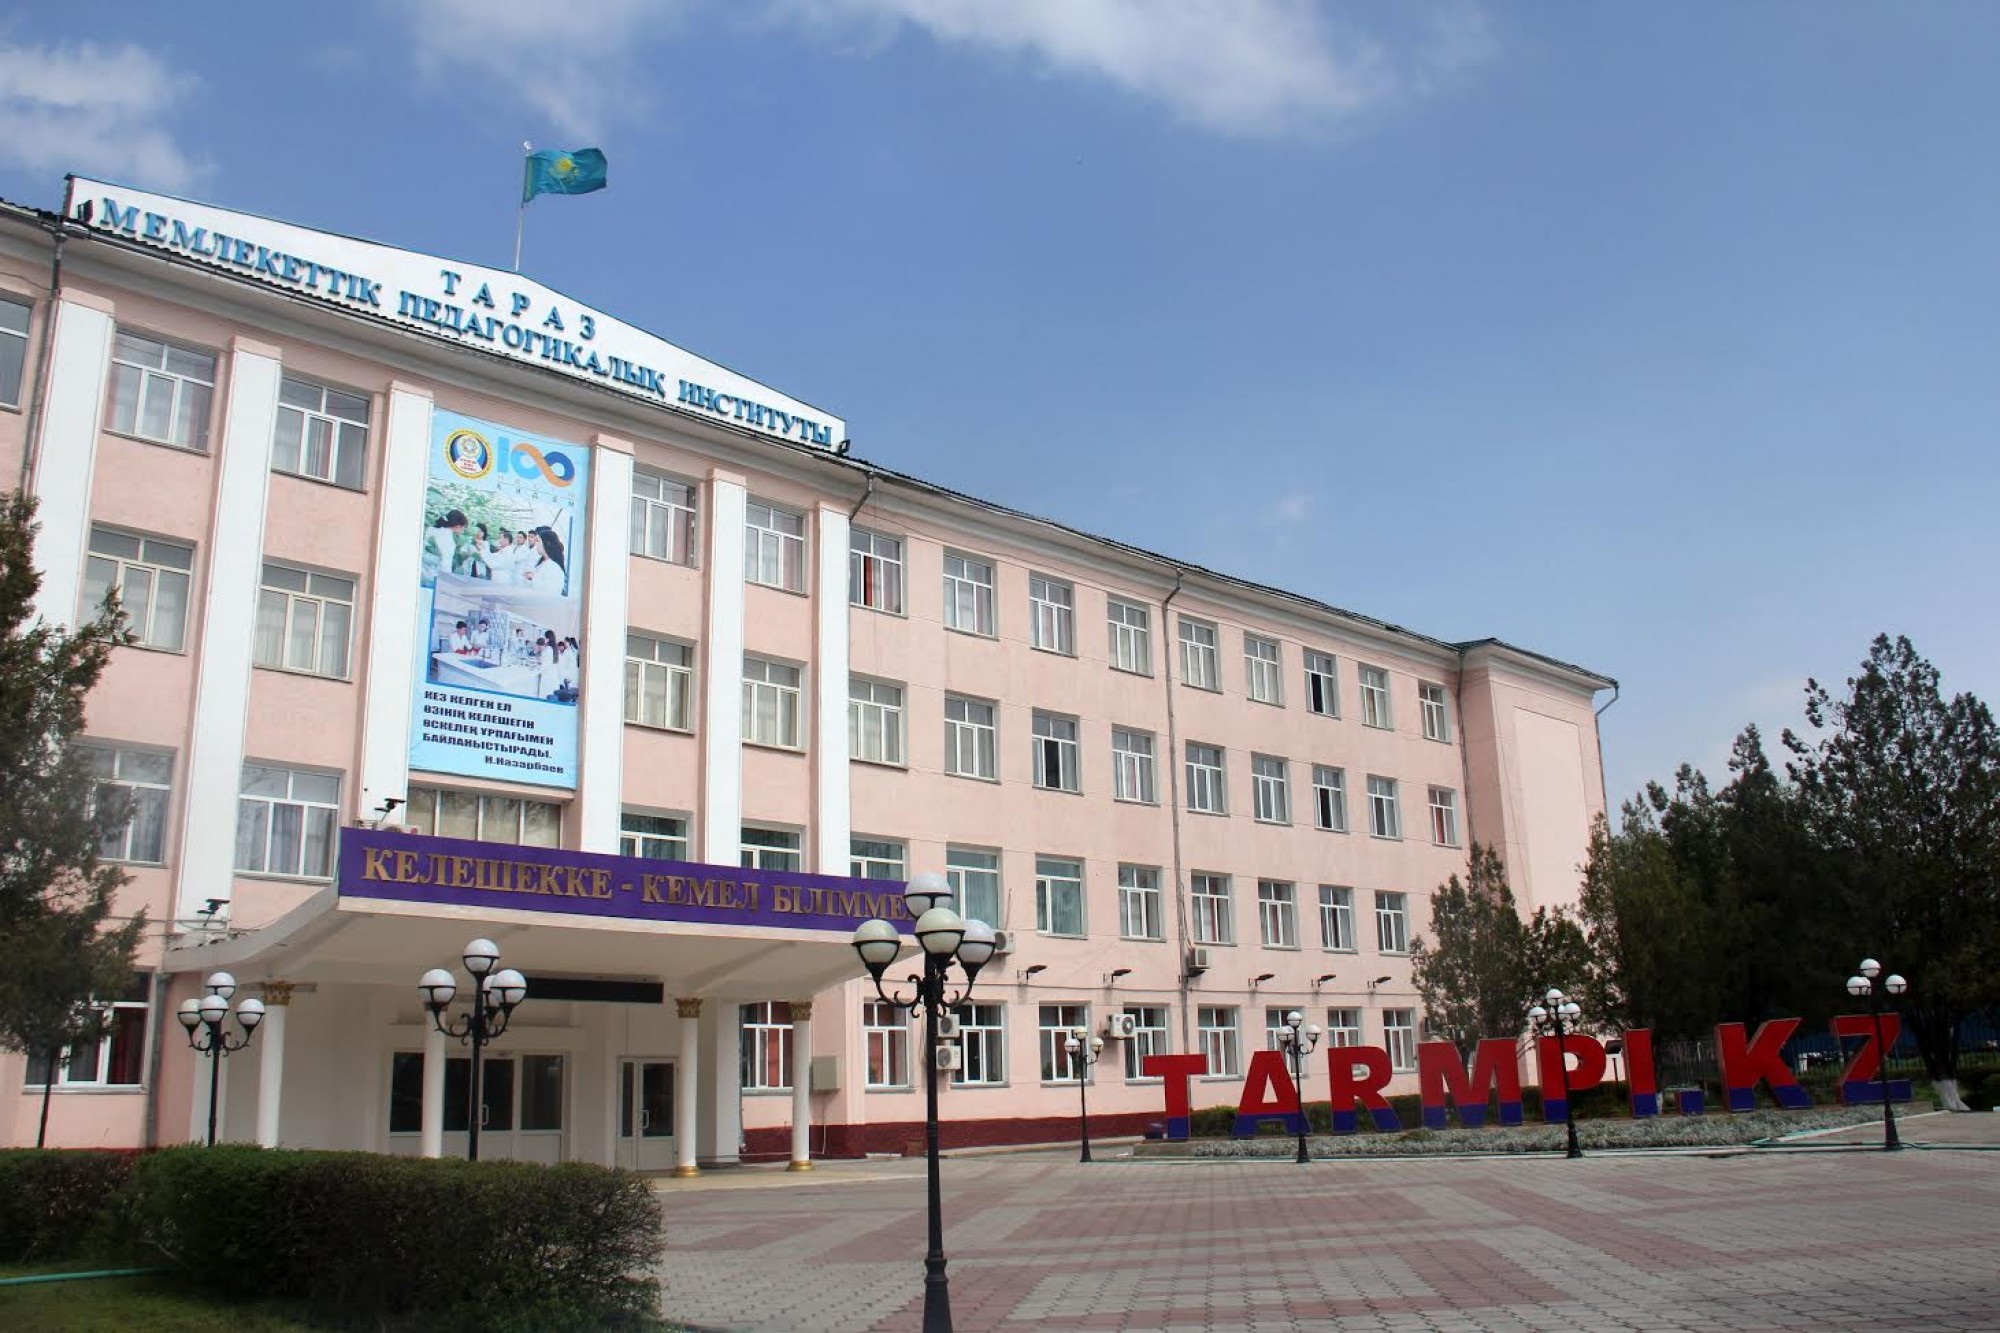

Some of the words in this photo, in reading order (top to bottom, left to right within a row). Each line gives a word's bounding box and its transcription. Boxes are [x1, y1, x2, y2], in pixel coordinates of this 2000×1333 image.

[99, 197, 383, 307] МЕМЛЕКЕТТІК
[398, 290, 666, 397] ПЕДАГОГИКАЛЫҚ
[678, 378, 833, 447] ИНСТИТУТЫ
[441, 269, 597, 340] ТАРАЗ
[423, 705, 465, 720] ӨЗІНІҢ
[468, 711, 535, 729] КЕЛЕШЕГІН
[424, 690, 447, 702] КЕЗ
[450, 694, 494, 710] КЕЛГЕН
[497, 702, 512, 713] ЕЛ
[362, 847, 613, 900] КЕЛЕШЕККЕ
[642, 873, 760, 913] КЕМЕЛ
[773, 884, 912, 921] БІЛІММЕ
